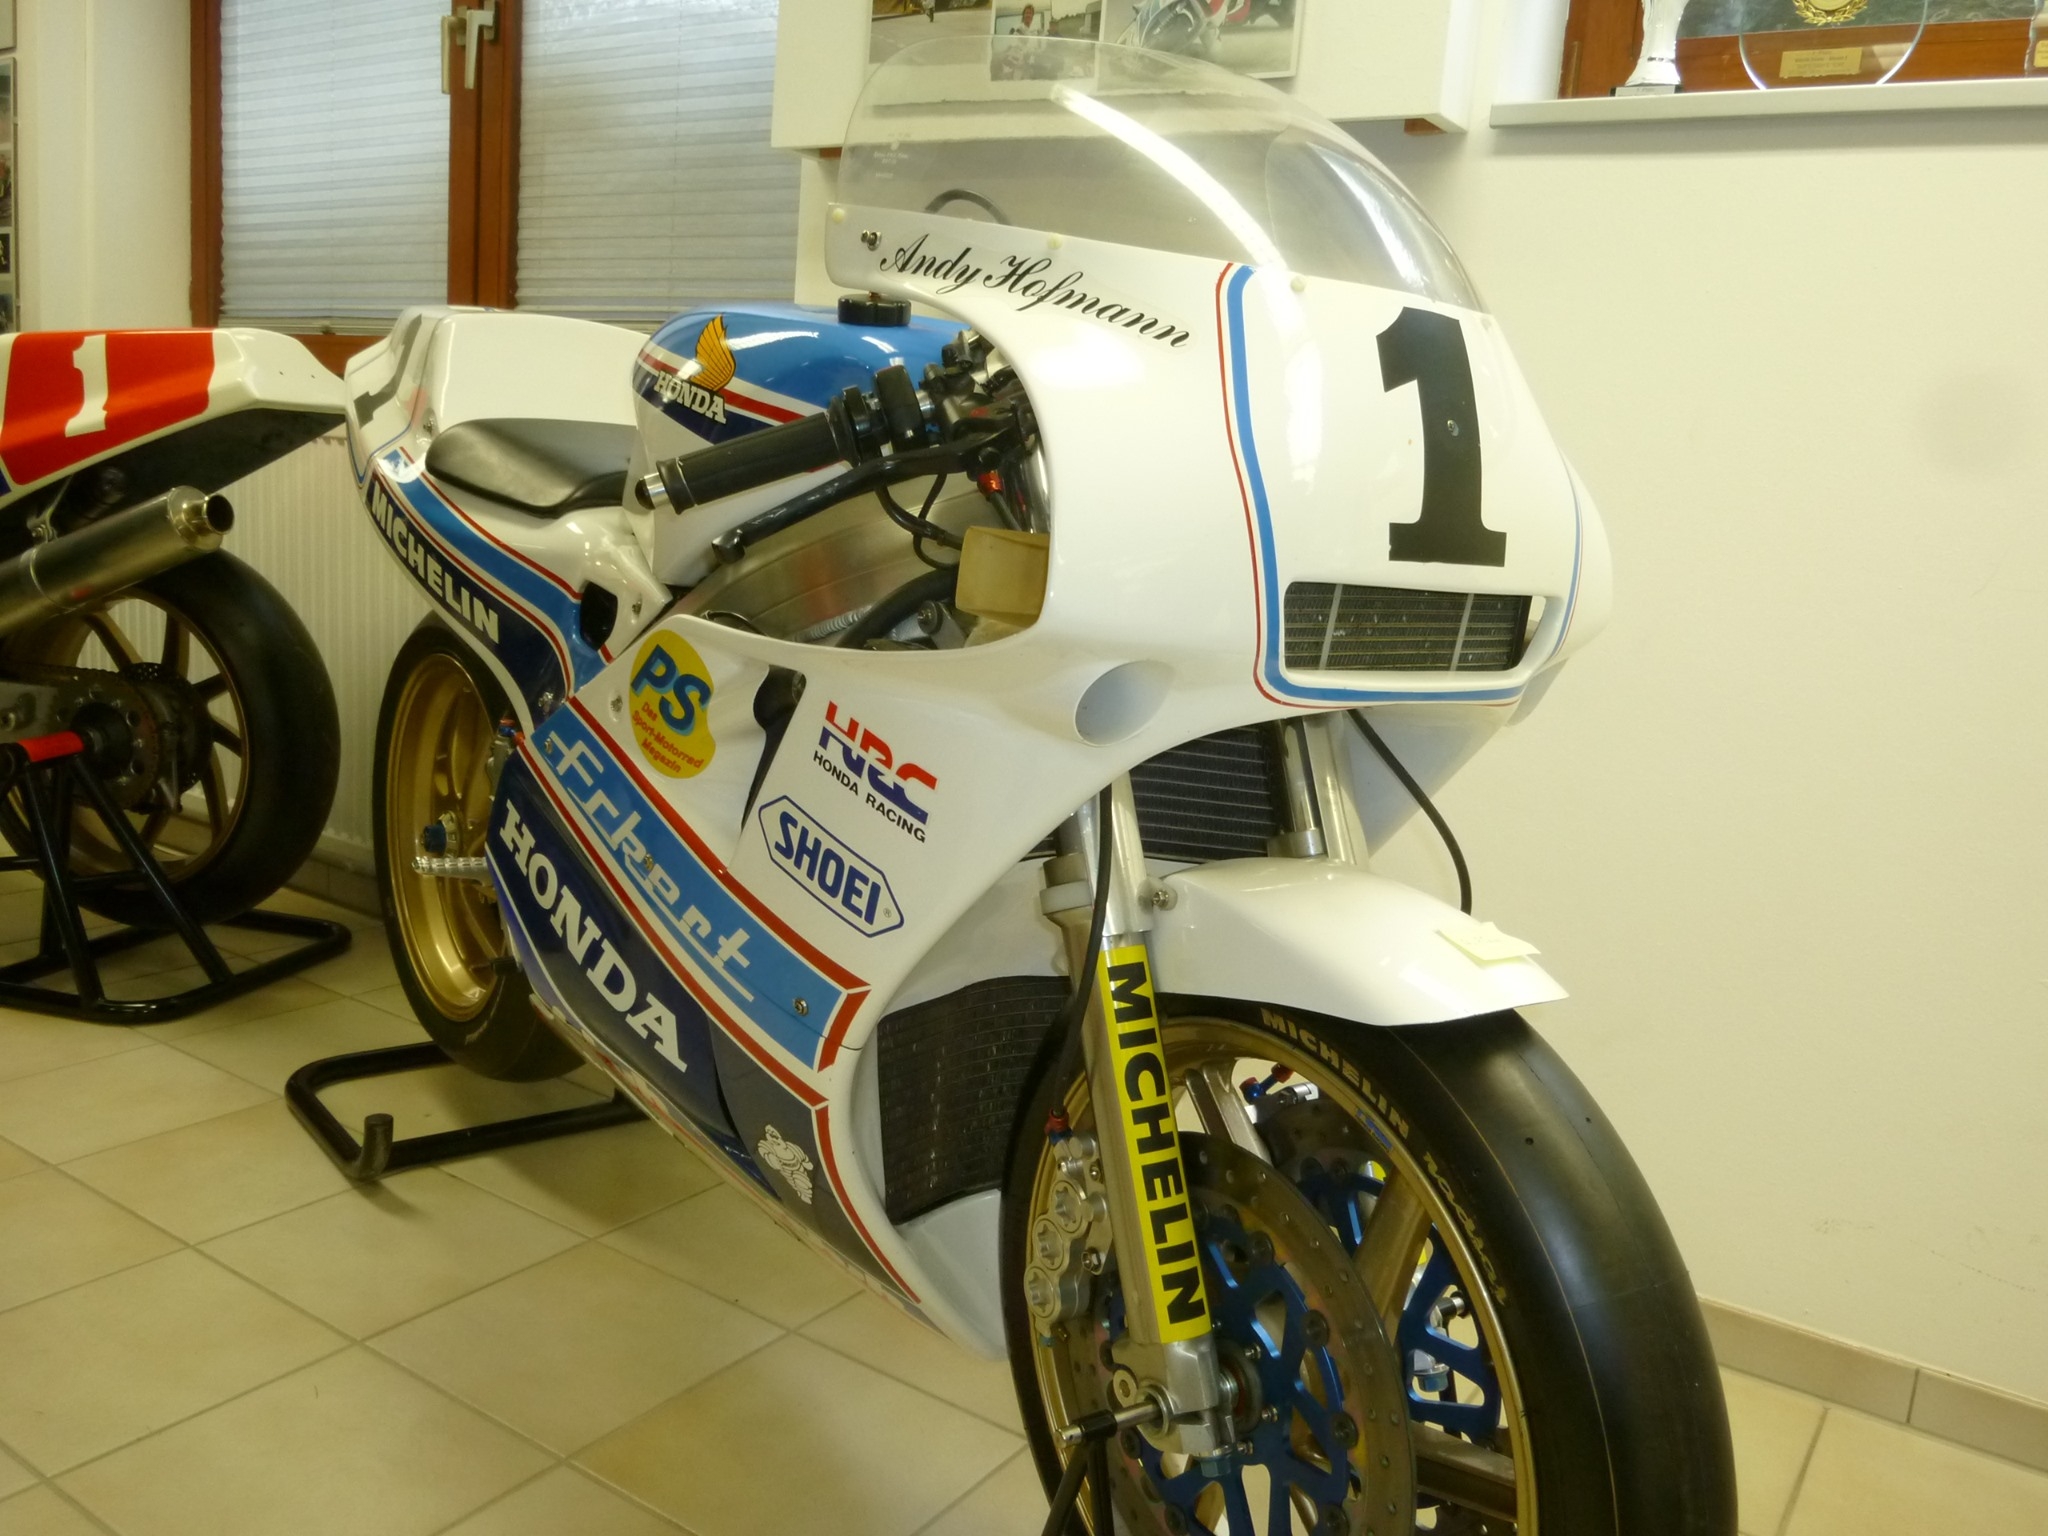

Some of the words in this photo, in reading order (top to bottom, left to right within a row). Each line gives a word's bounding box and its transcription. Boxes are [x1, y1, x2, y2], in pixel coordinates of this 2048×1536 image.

[880, 233, 982, 295] Andy
[983, 255, 1191, 348] Hofmann
[65, 334, 108, 438] 1
[653, 370, 727, 424] HONDA
[1376, 306, 1507, 567] 1
[372, 480, 499, 644] MICHELIN
[631, 644, 712, 737] PS
[632, 710, 705, 769] Sport-Motorrad
[641, 702, 658, 722] Das
[641, 738, 682, 773] Magazin
[813, 750, 859, 796] HONDA
[865, 792, 926, 843] RACING
[818, 700, 938, 826] HRC
[774, 811, 881, 926] SHOEI
[499, 799, 688, 1073] HONDA
[1260, 1007, 1409, 1140] MICHELIN
[1107, 961, 1207, 1325] MICHELIN
